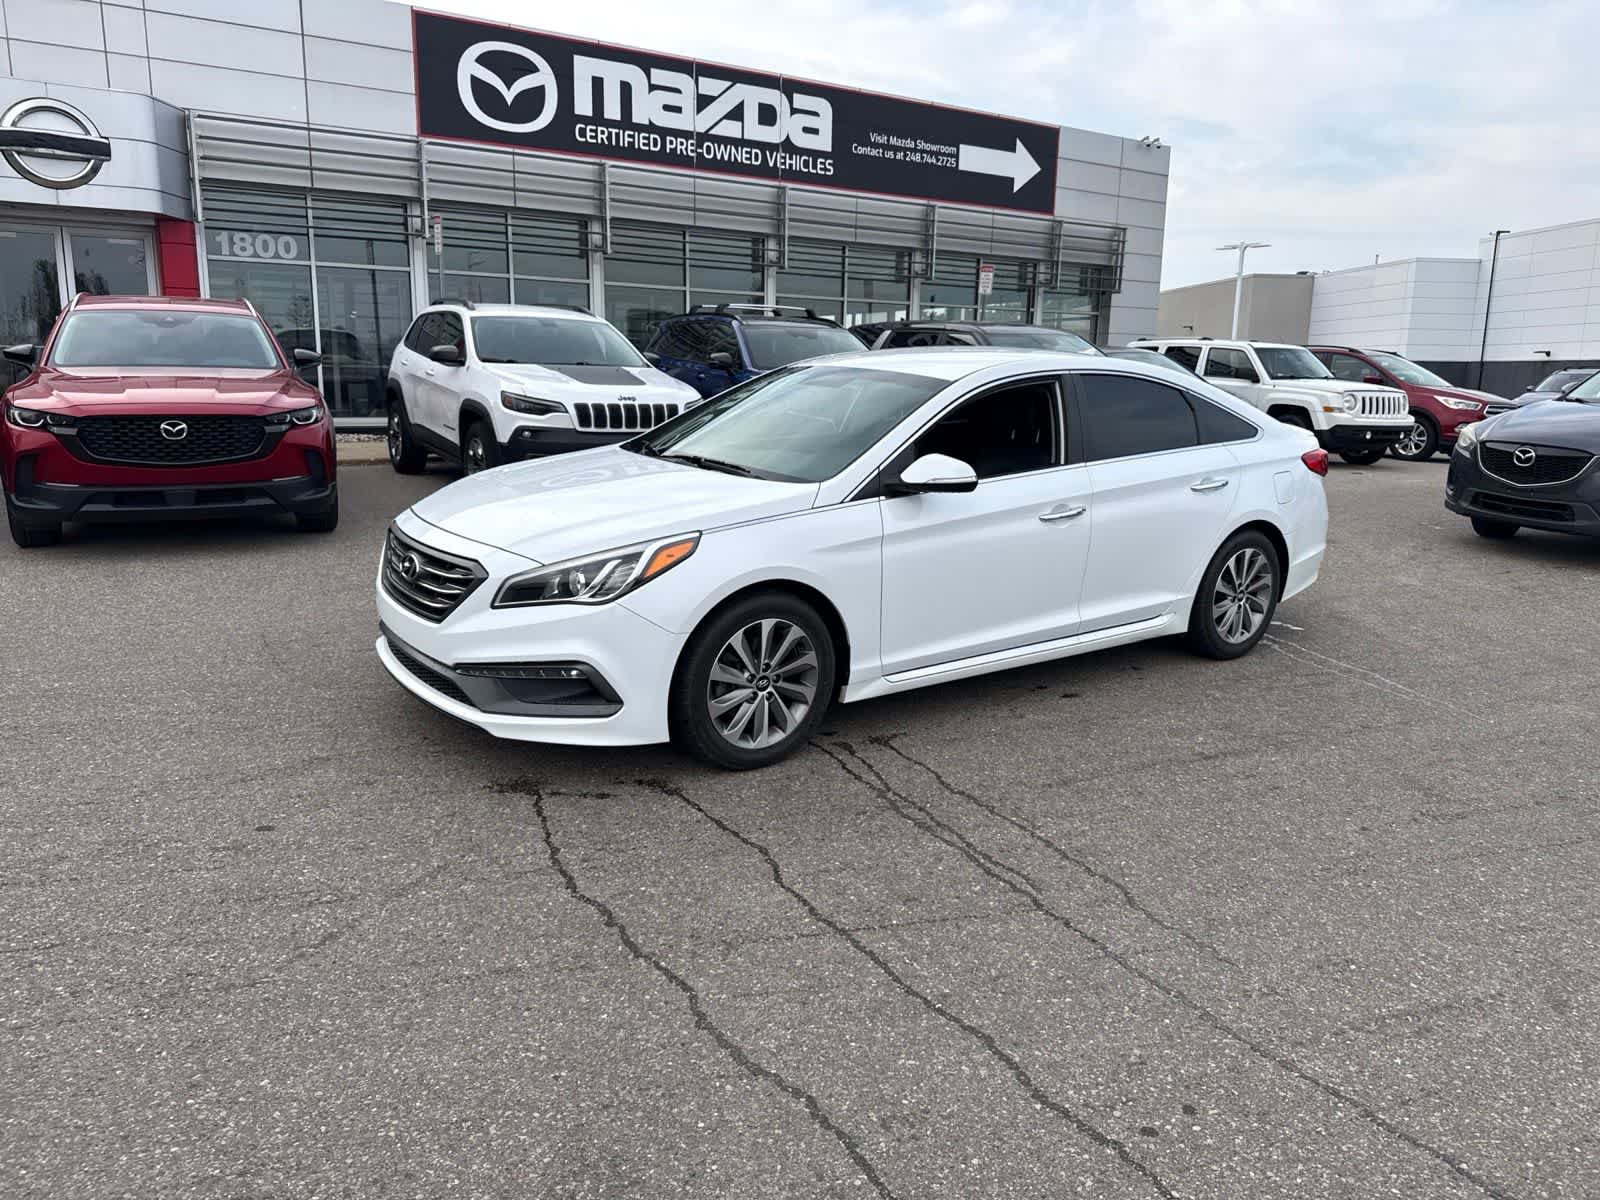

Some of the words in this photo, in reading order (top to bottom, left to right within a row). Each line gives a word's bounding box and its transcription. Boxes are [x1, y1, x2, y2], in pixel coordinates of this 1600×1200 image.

[575, 123, 661, 152] CERTIFIED
[666, 136, 762, 166] PRE-OWNED
[766, 151, 834, 176] VEHICLES
[852, 143, 883, 158] Contact
[884, 150, 895, 159] us
[896, 151, 904, 160] at
[905, 151, 957, 167] 248.744.2725
[869, 132, 888, 145] Visit
[889, 135, 915, 149] Mazda
[916, 139, 957, 154] Showroom
[215, 231, 298, 259] 1800
